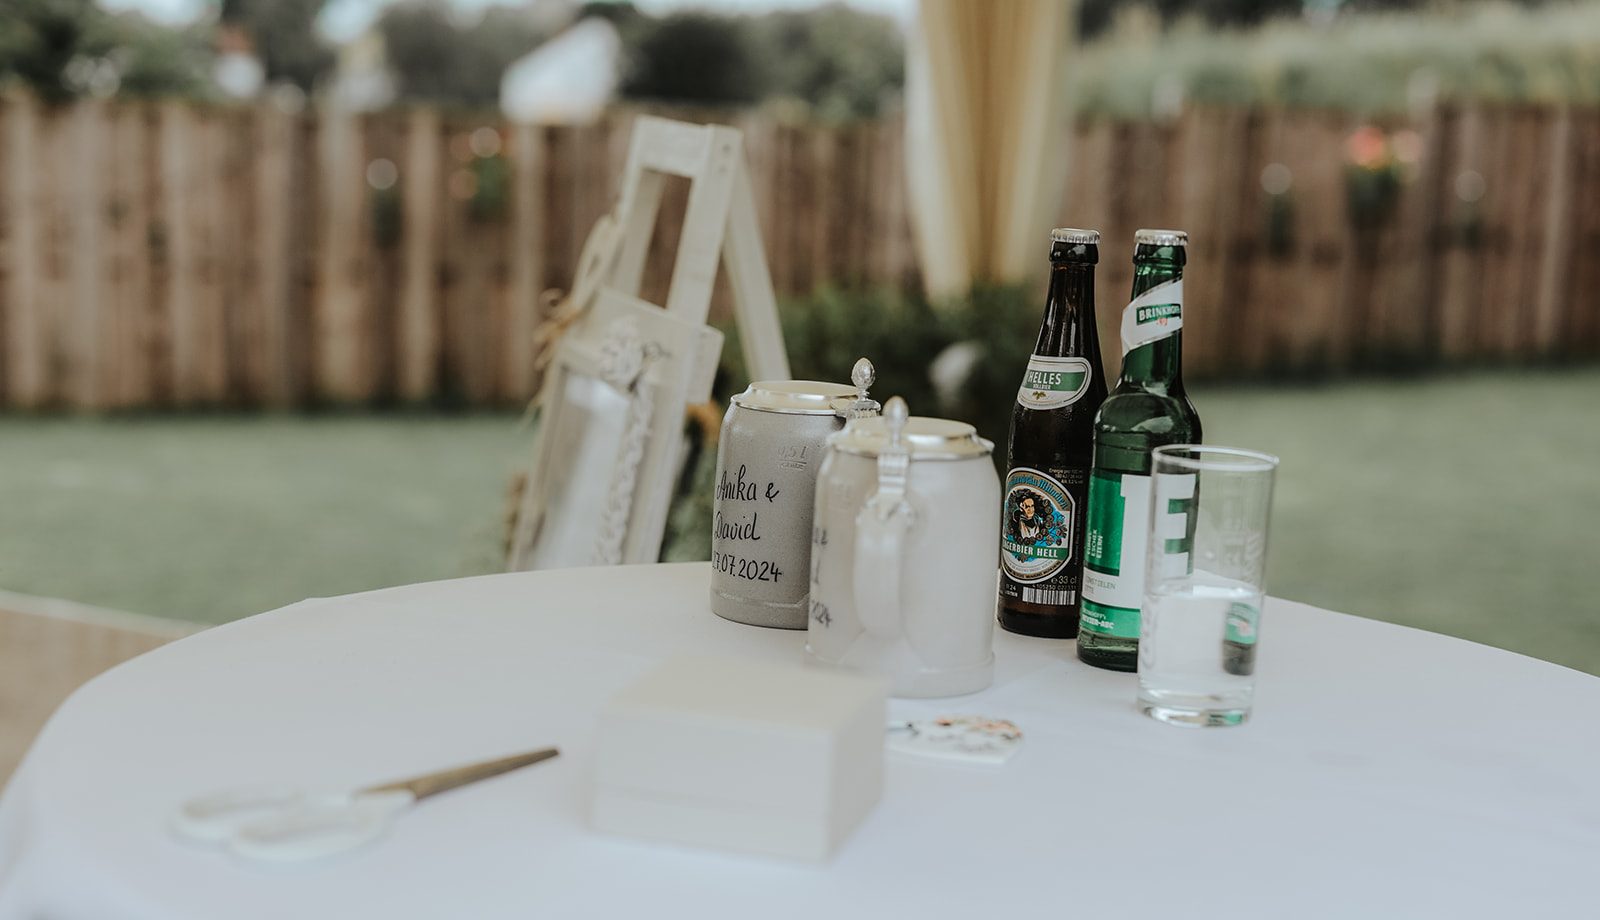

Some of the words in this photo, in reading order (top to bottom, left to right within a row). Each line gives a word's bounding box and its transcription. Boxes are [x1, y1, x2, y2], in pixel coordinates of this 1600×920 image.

[1027, 371, 1062, 385] HELLES
[717, 464, 757, 501] Anika
[765, 482, 780, 503] &
[714, 511, 761, 541] David
[1036, 548, 1058, 558] HELL
[1058, 575, 1069, 584] 33
